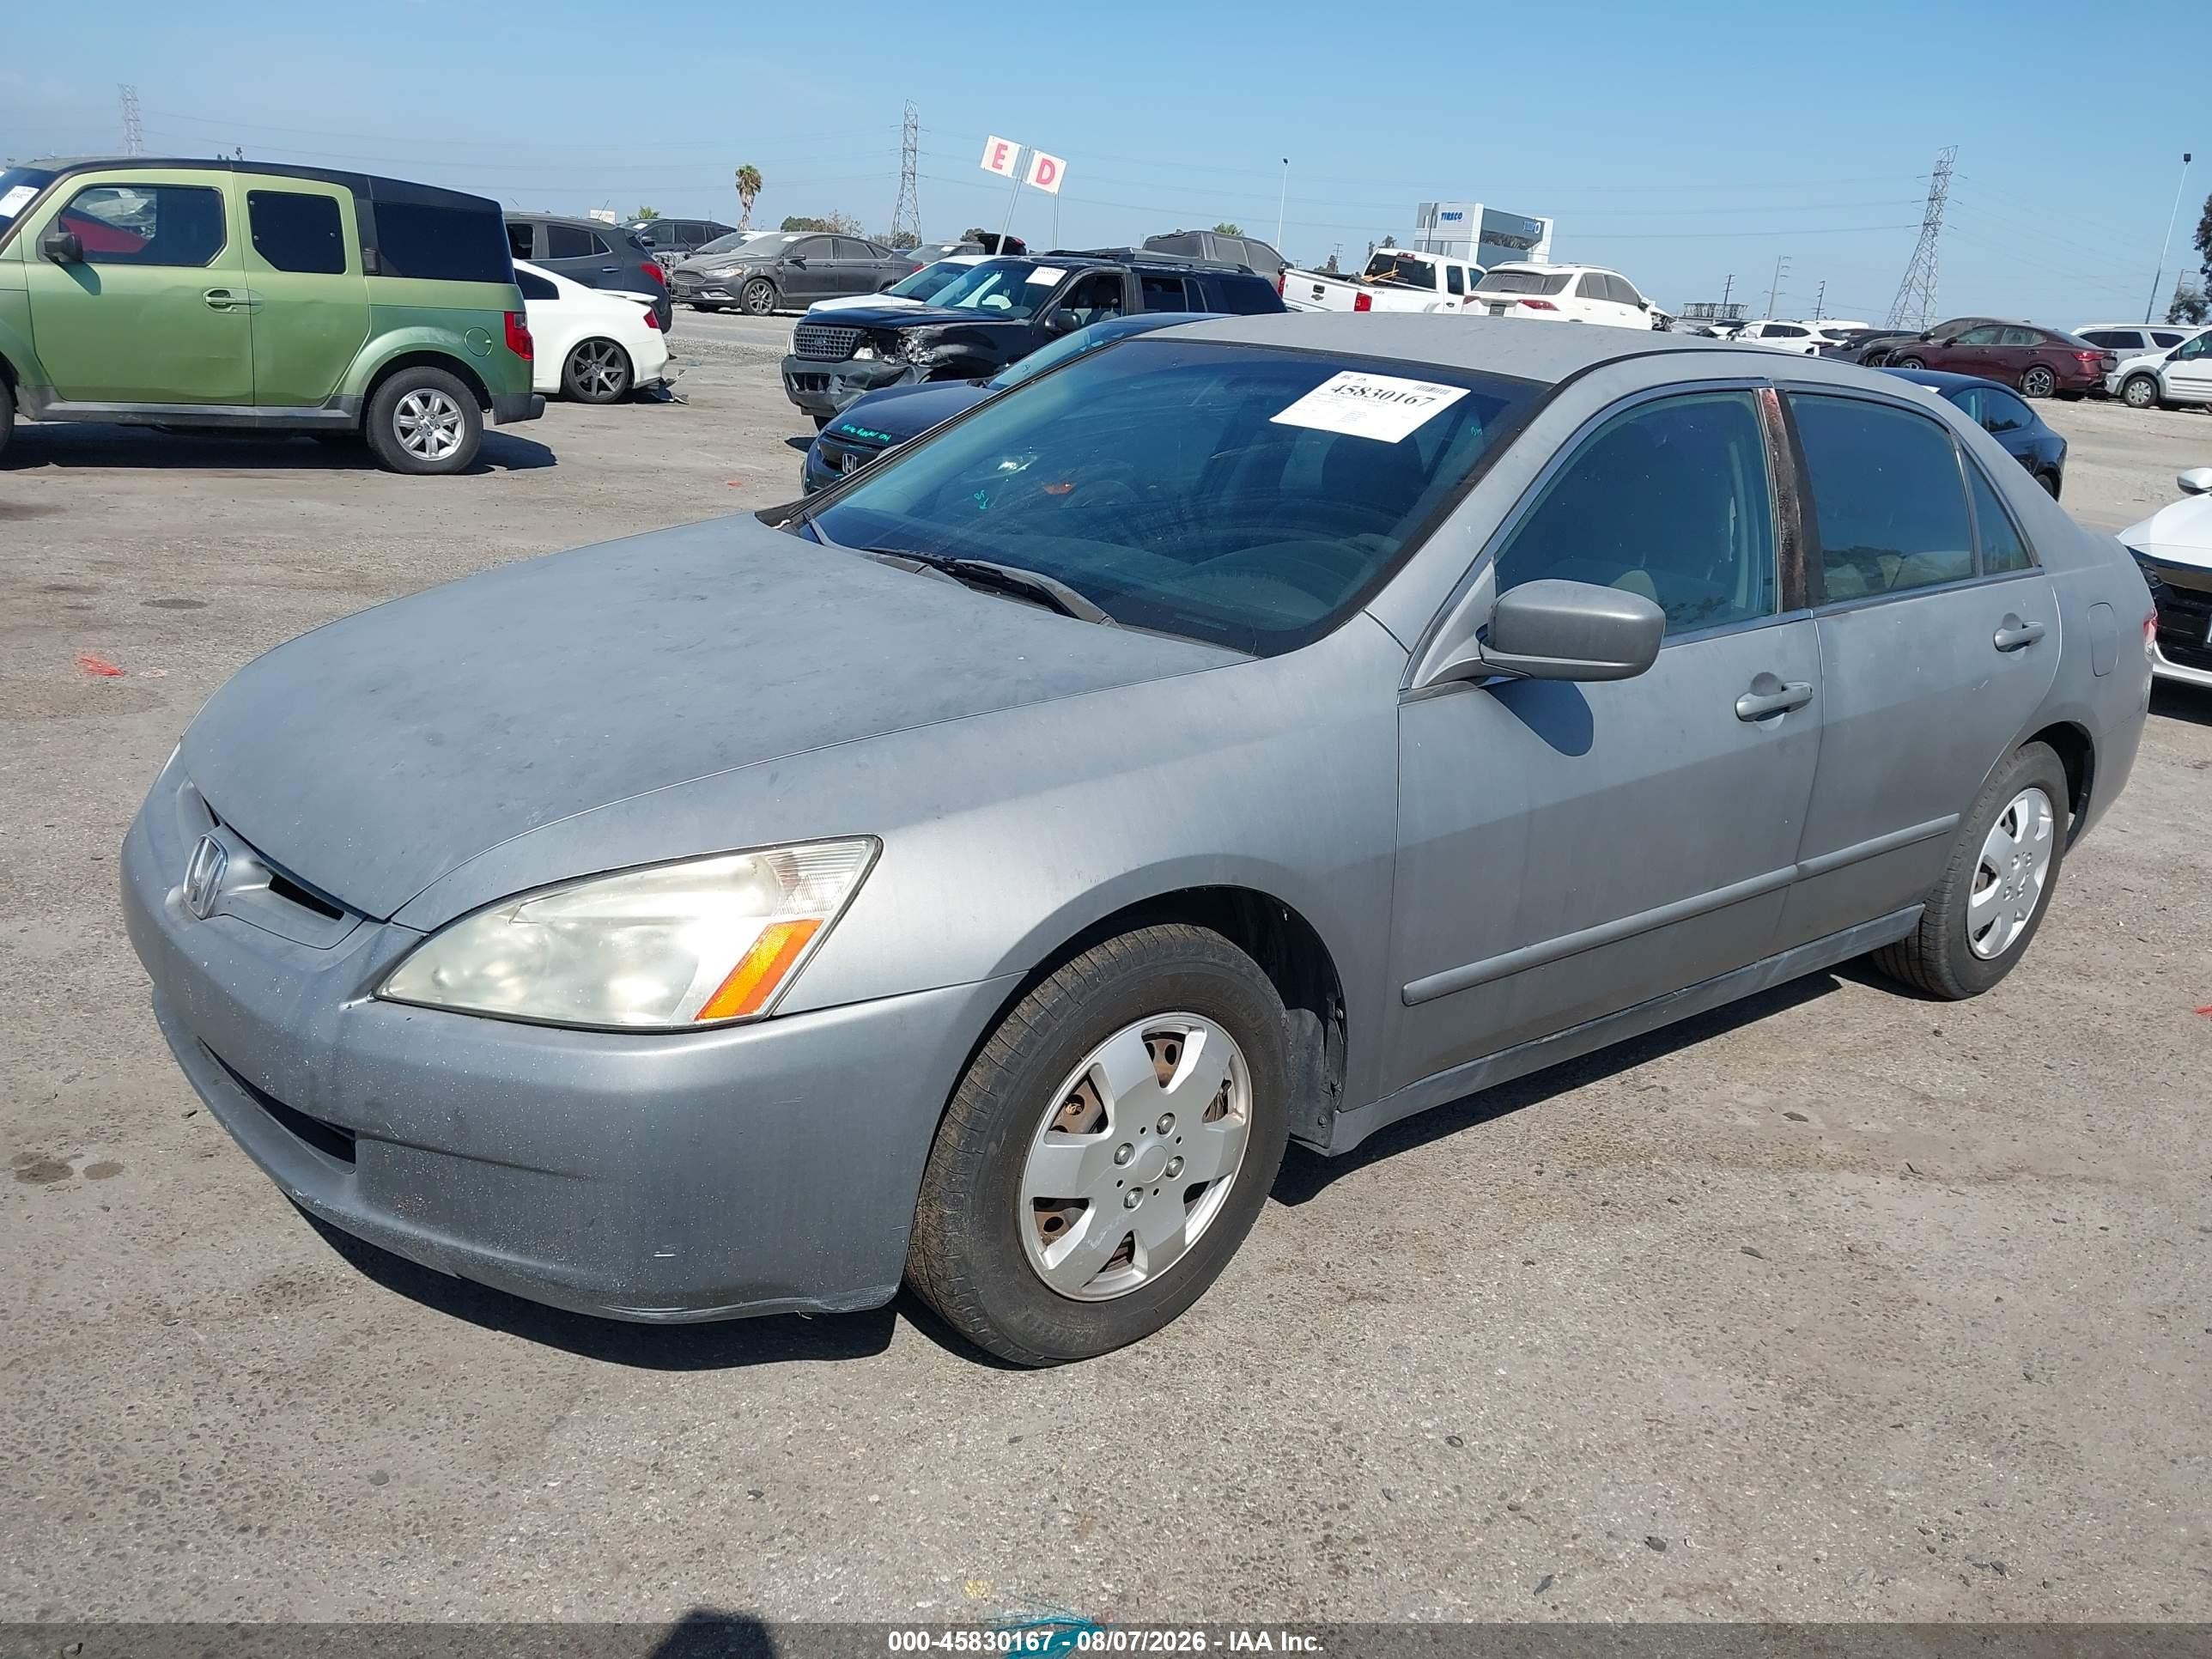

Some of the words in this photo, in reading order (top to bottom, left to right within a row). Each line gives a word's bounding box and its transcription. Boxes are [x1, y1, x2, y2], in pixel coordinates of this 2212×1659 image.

[992, 143, 1008, 170] E
[1036, 158, 1055, 185] D
[1330, 384, 1437, 407] 45830167
